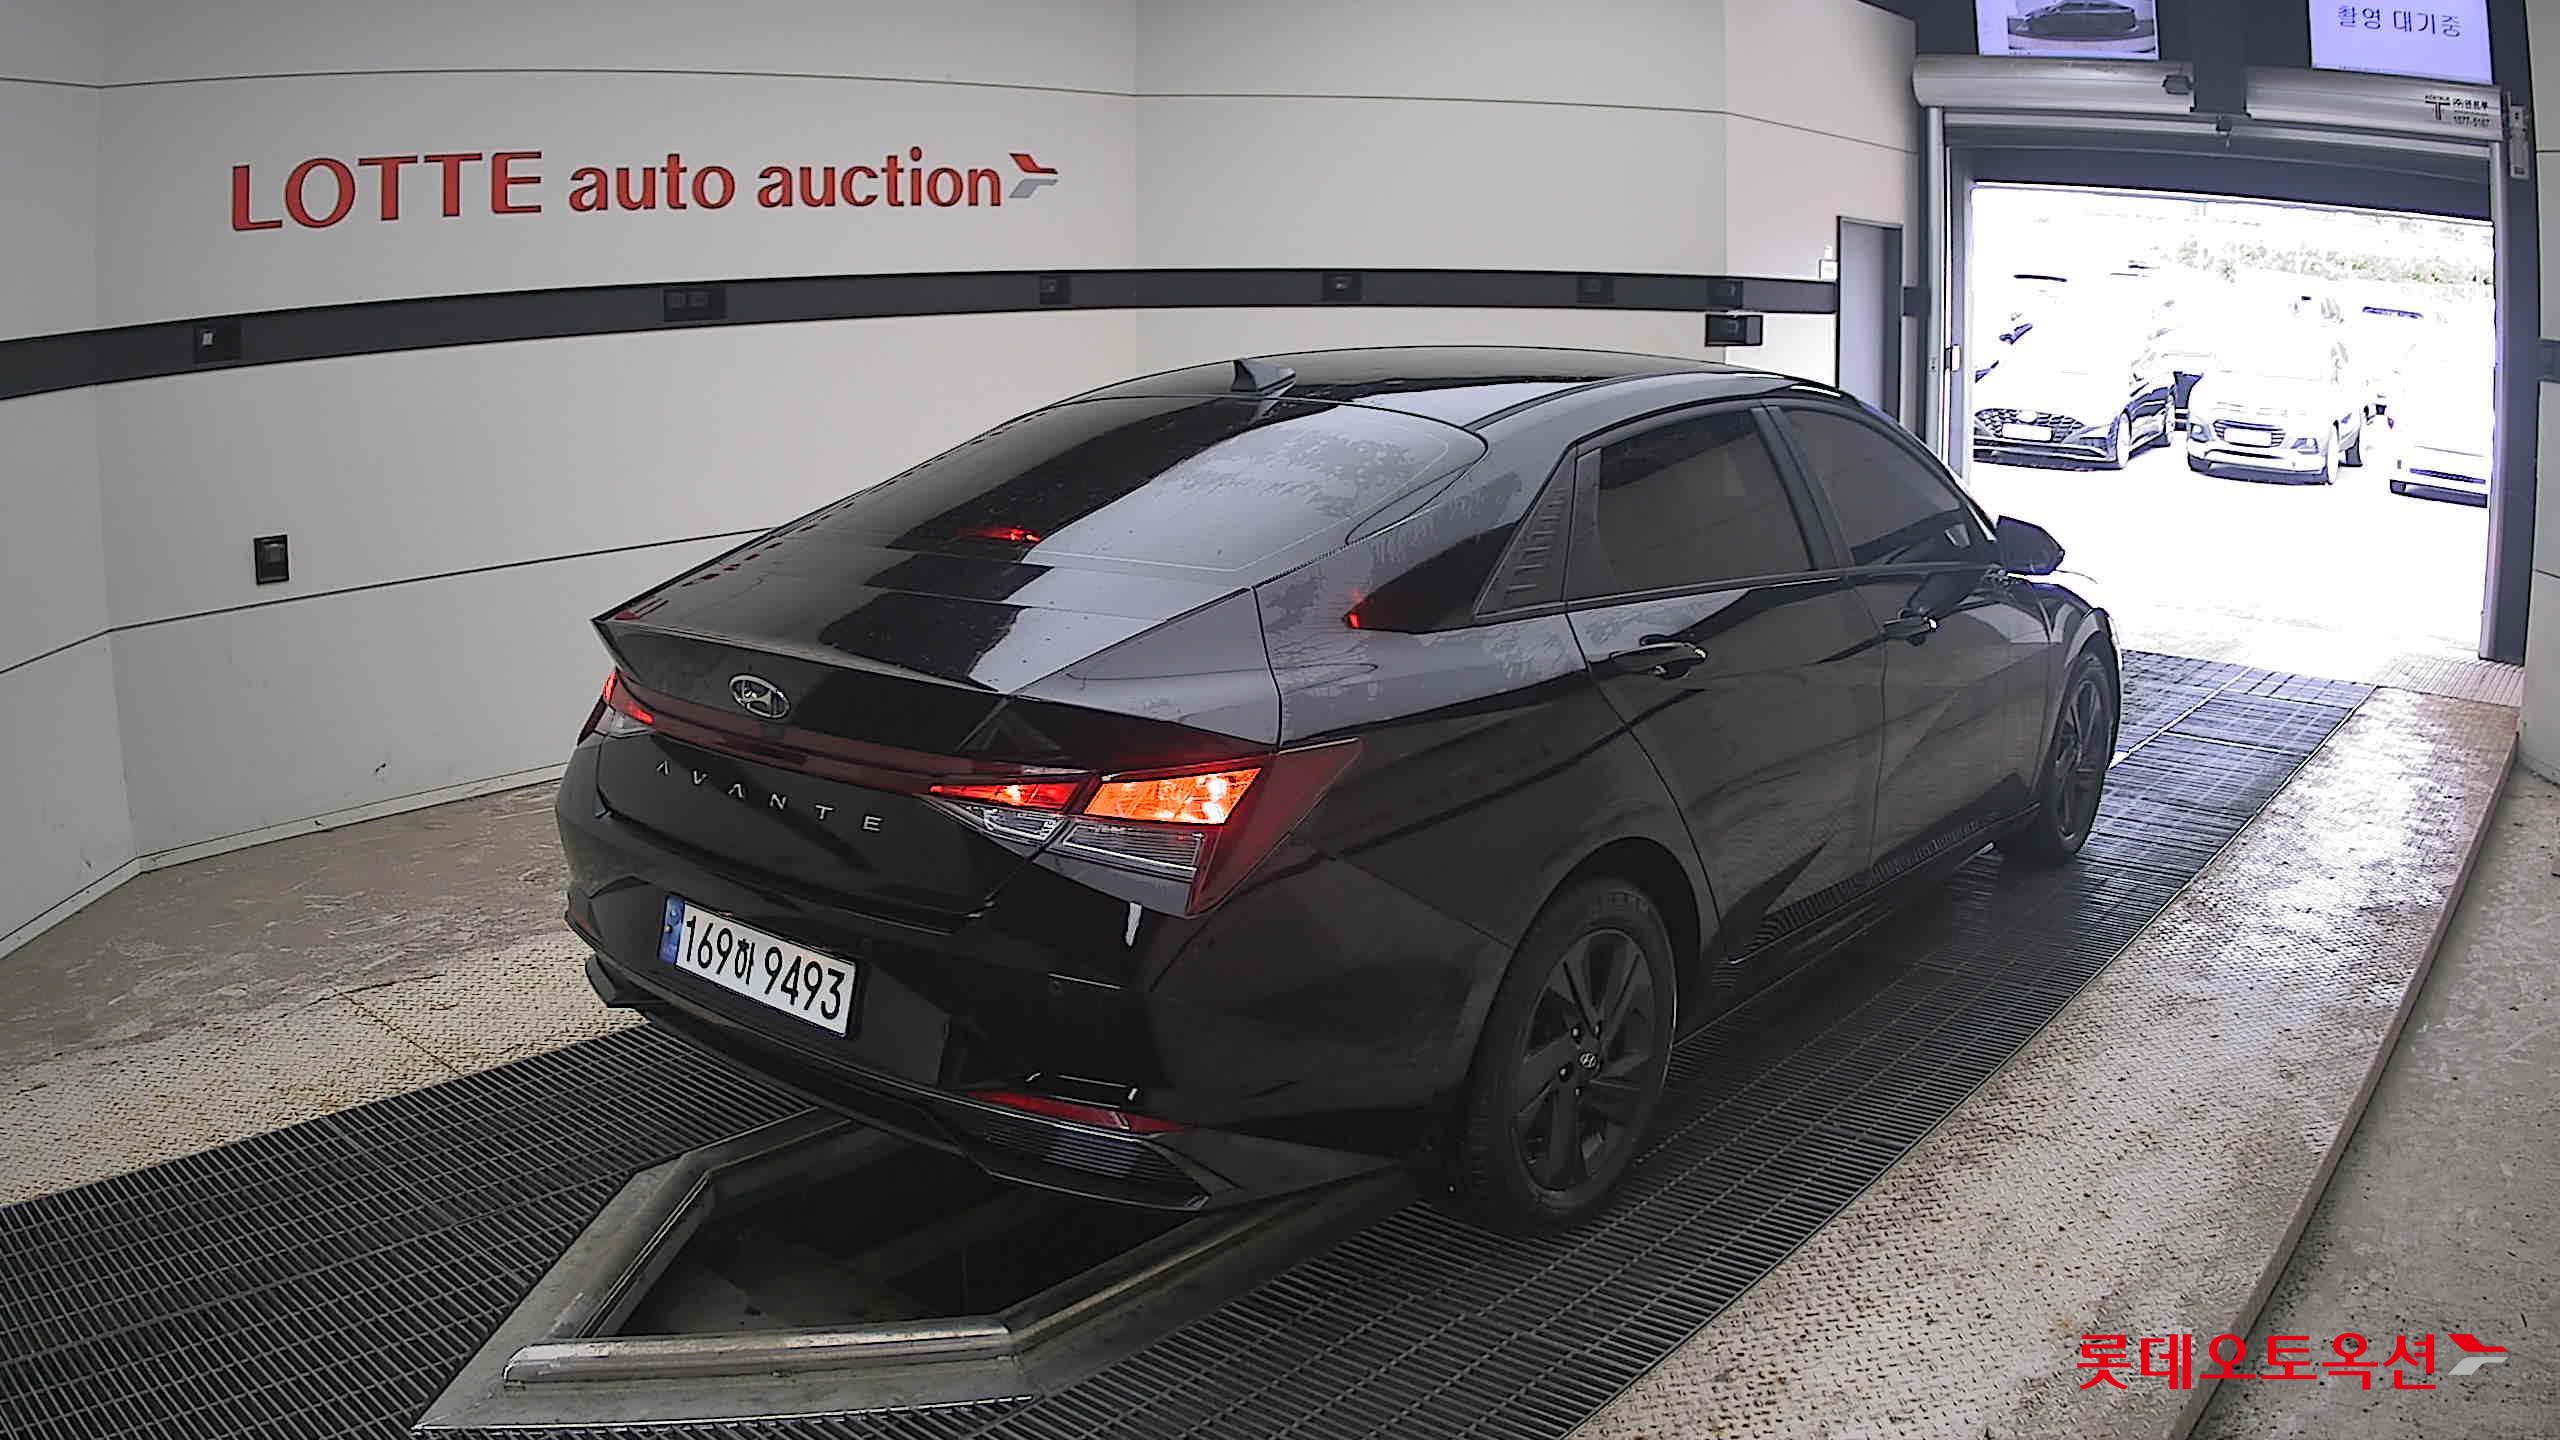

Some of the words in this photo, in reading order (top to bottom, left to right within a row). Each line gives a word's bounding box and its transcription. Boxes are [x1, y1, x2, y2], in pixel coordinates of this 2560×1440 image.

[2337, 4, 2382, 31] 촬영
[2392, 9, 2462, 38] 대기중
[232, 151, 542, 231] LOTTE
[568, 154, 738, 212] auto
[756, 148, 1005, 208] auction
[656, 759, 884, 832] AVANTE
[685, 915, 756, 985] 169하
[764, 946, 846, 1020] 9493
